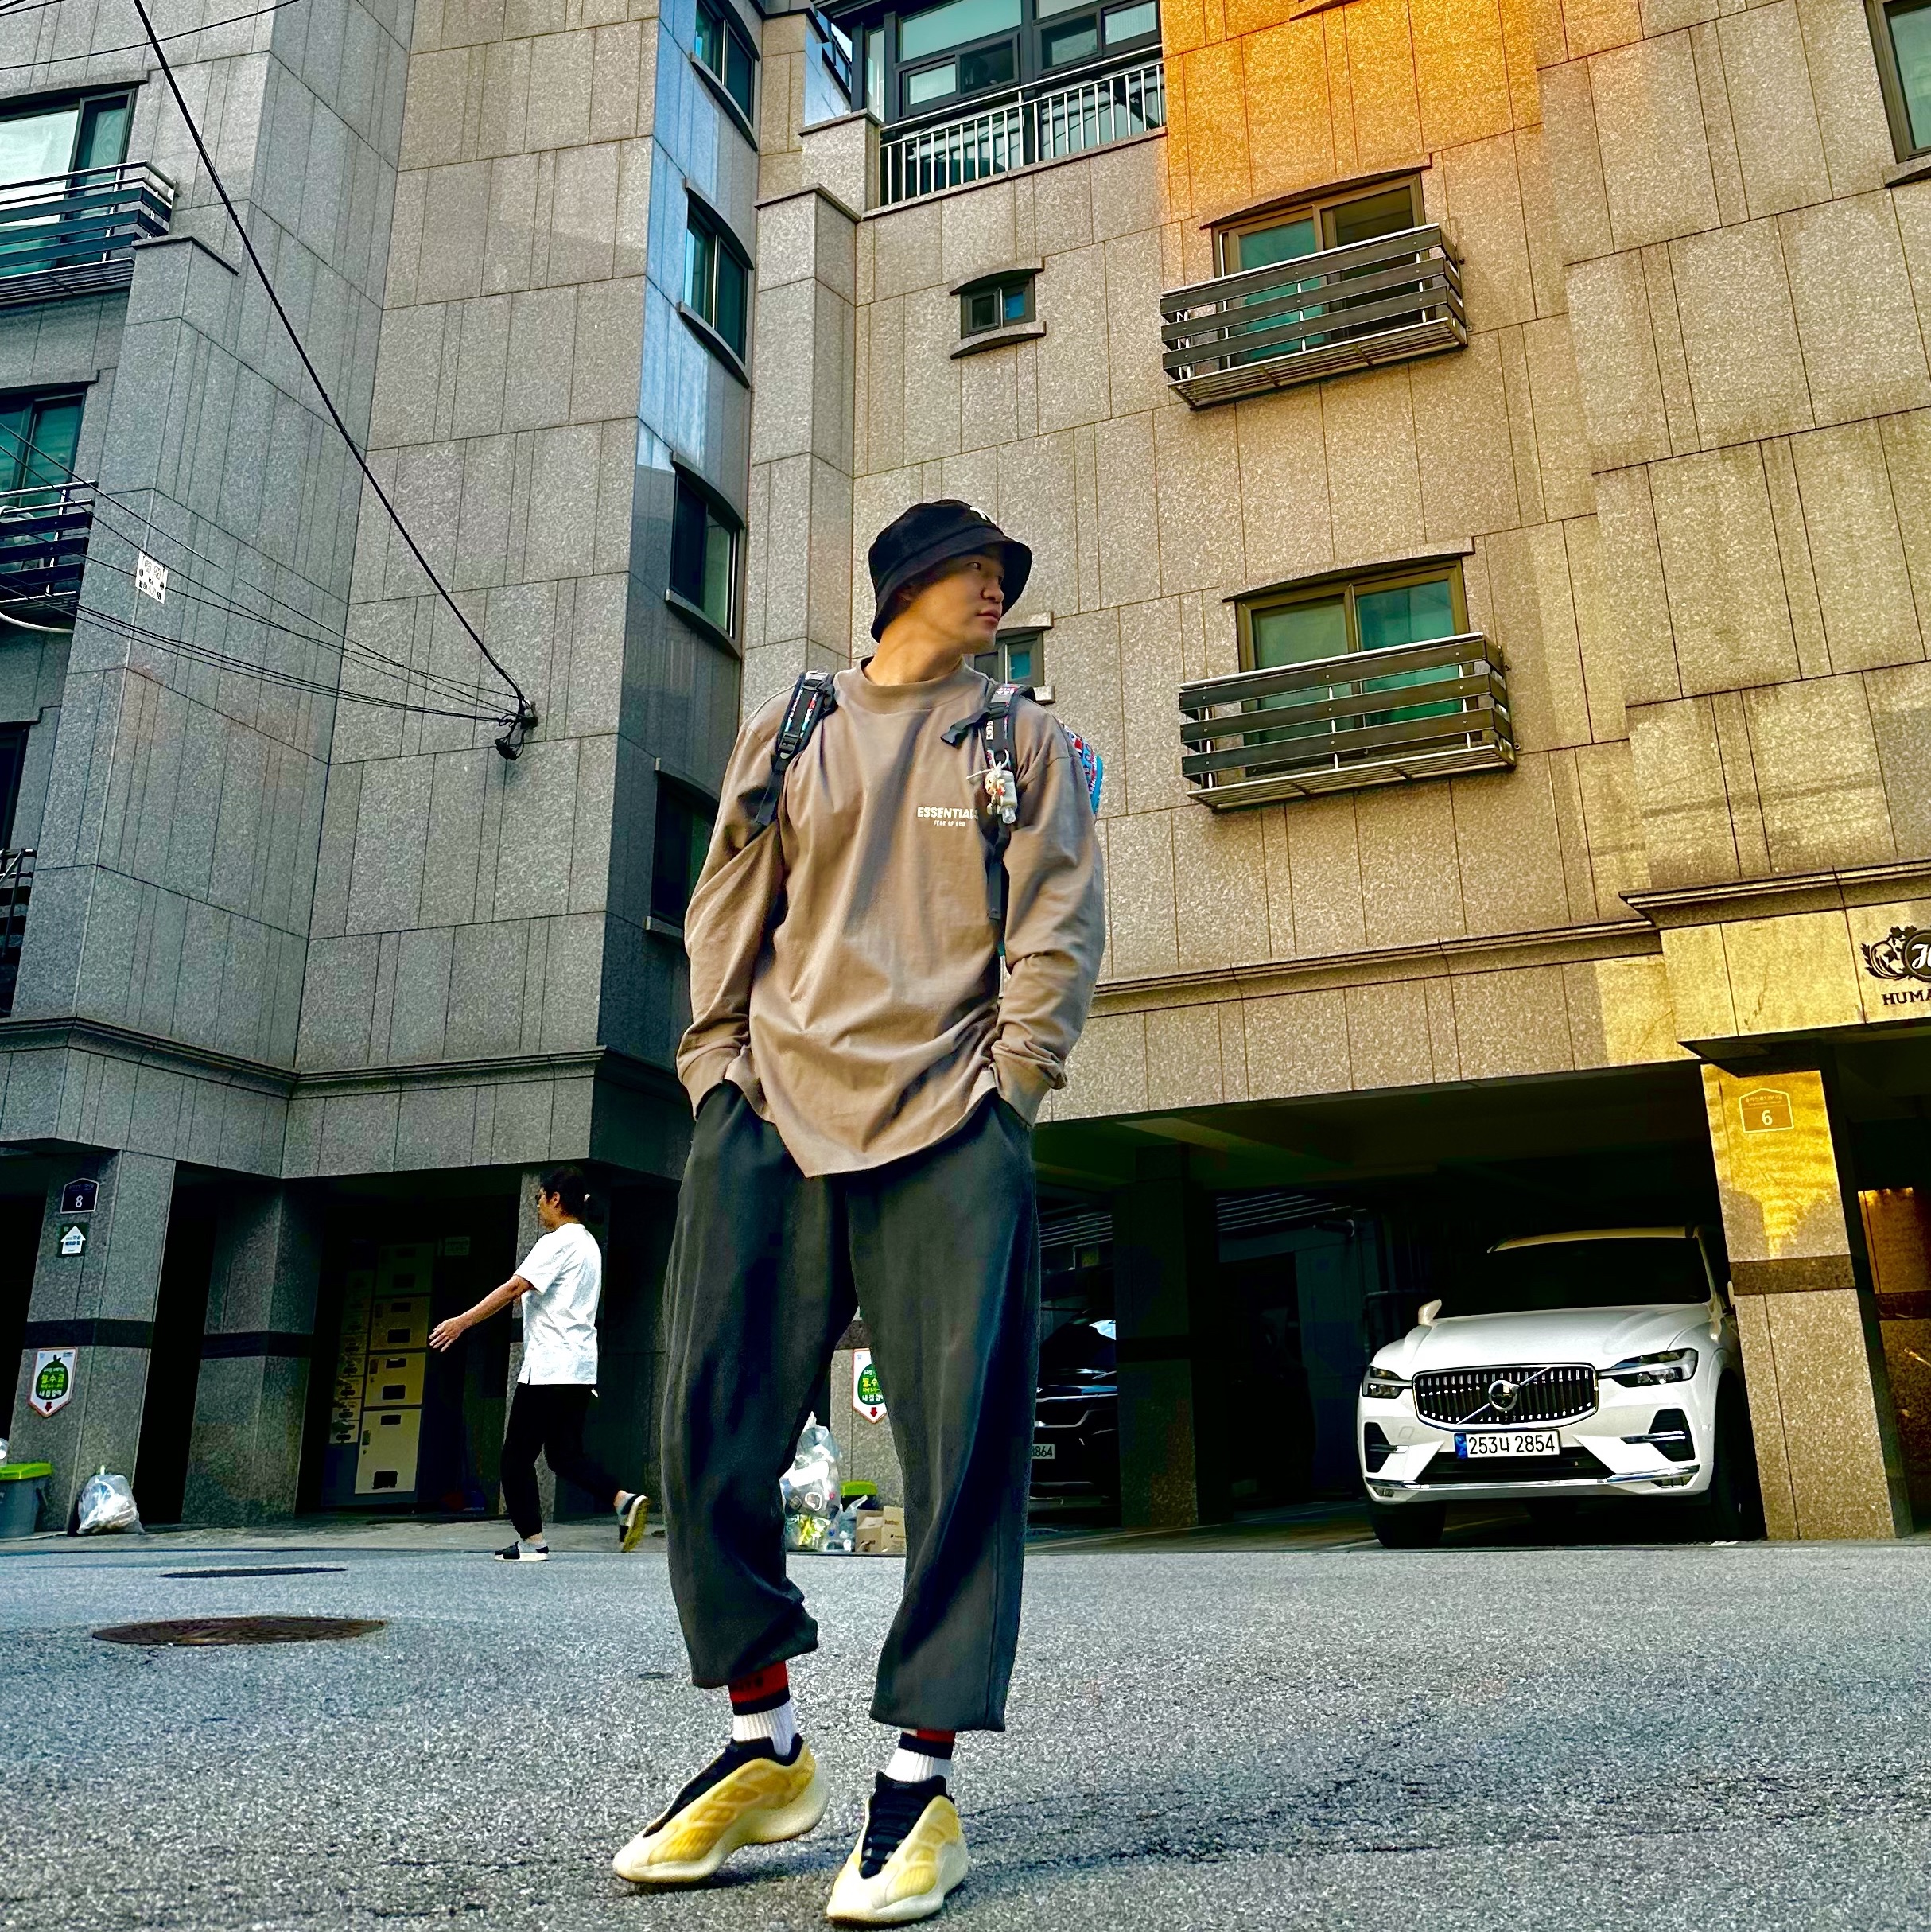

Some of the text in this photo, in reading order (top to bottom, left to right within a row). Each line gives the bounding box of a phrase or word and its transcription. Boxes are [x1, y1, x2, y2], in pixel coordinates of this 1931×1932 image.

[1762, 1110, 1773, 1126] 6
[75, 1195, 84, 1208] 8
[1514, 1434, 1555, 1453] 2854
[1032, 1445, 1053, 1457] 864
